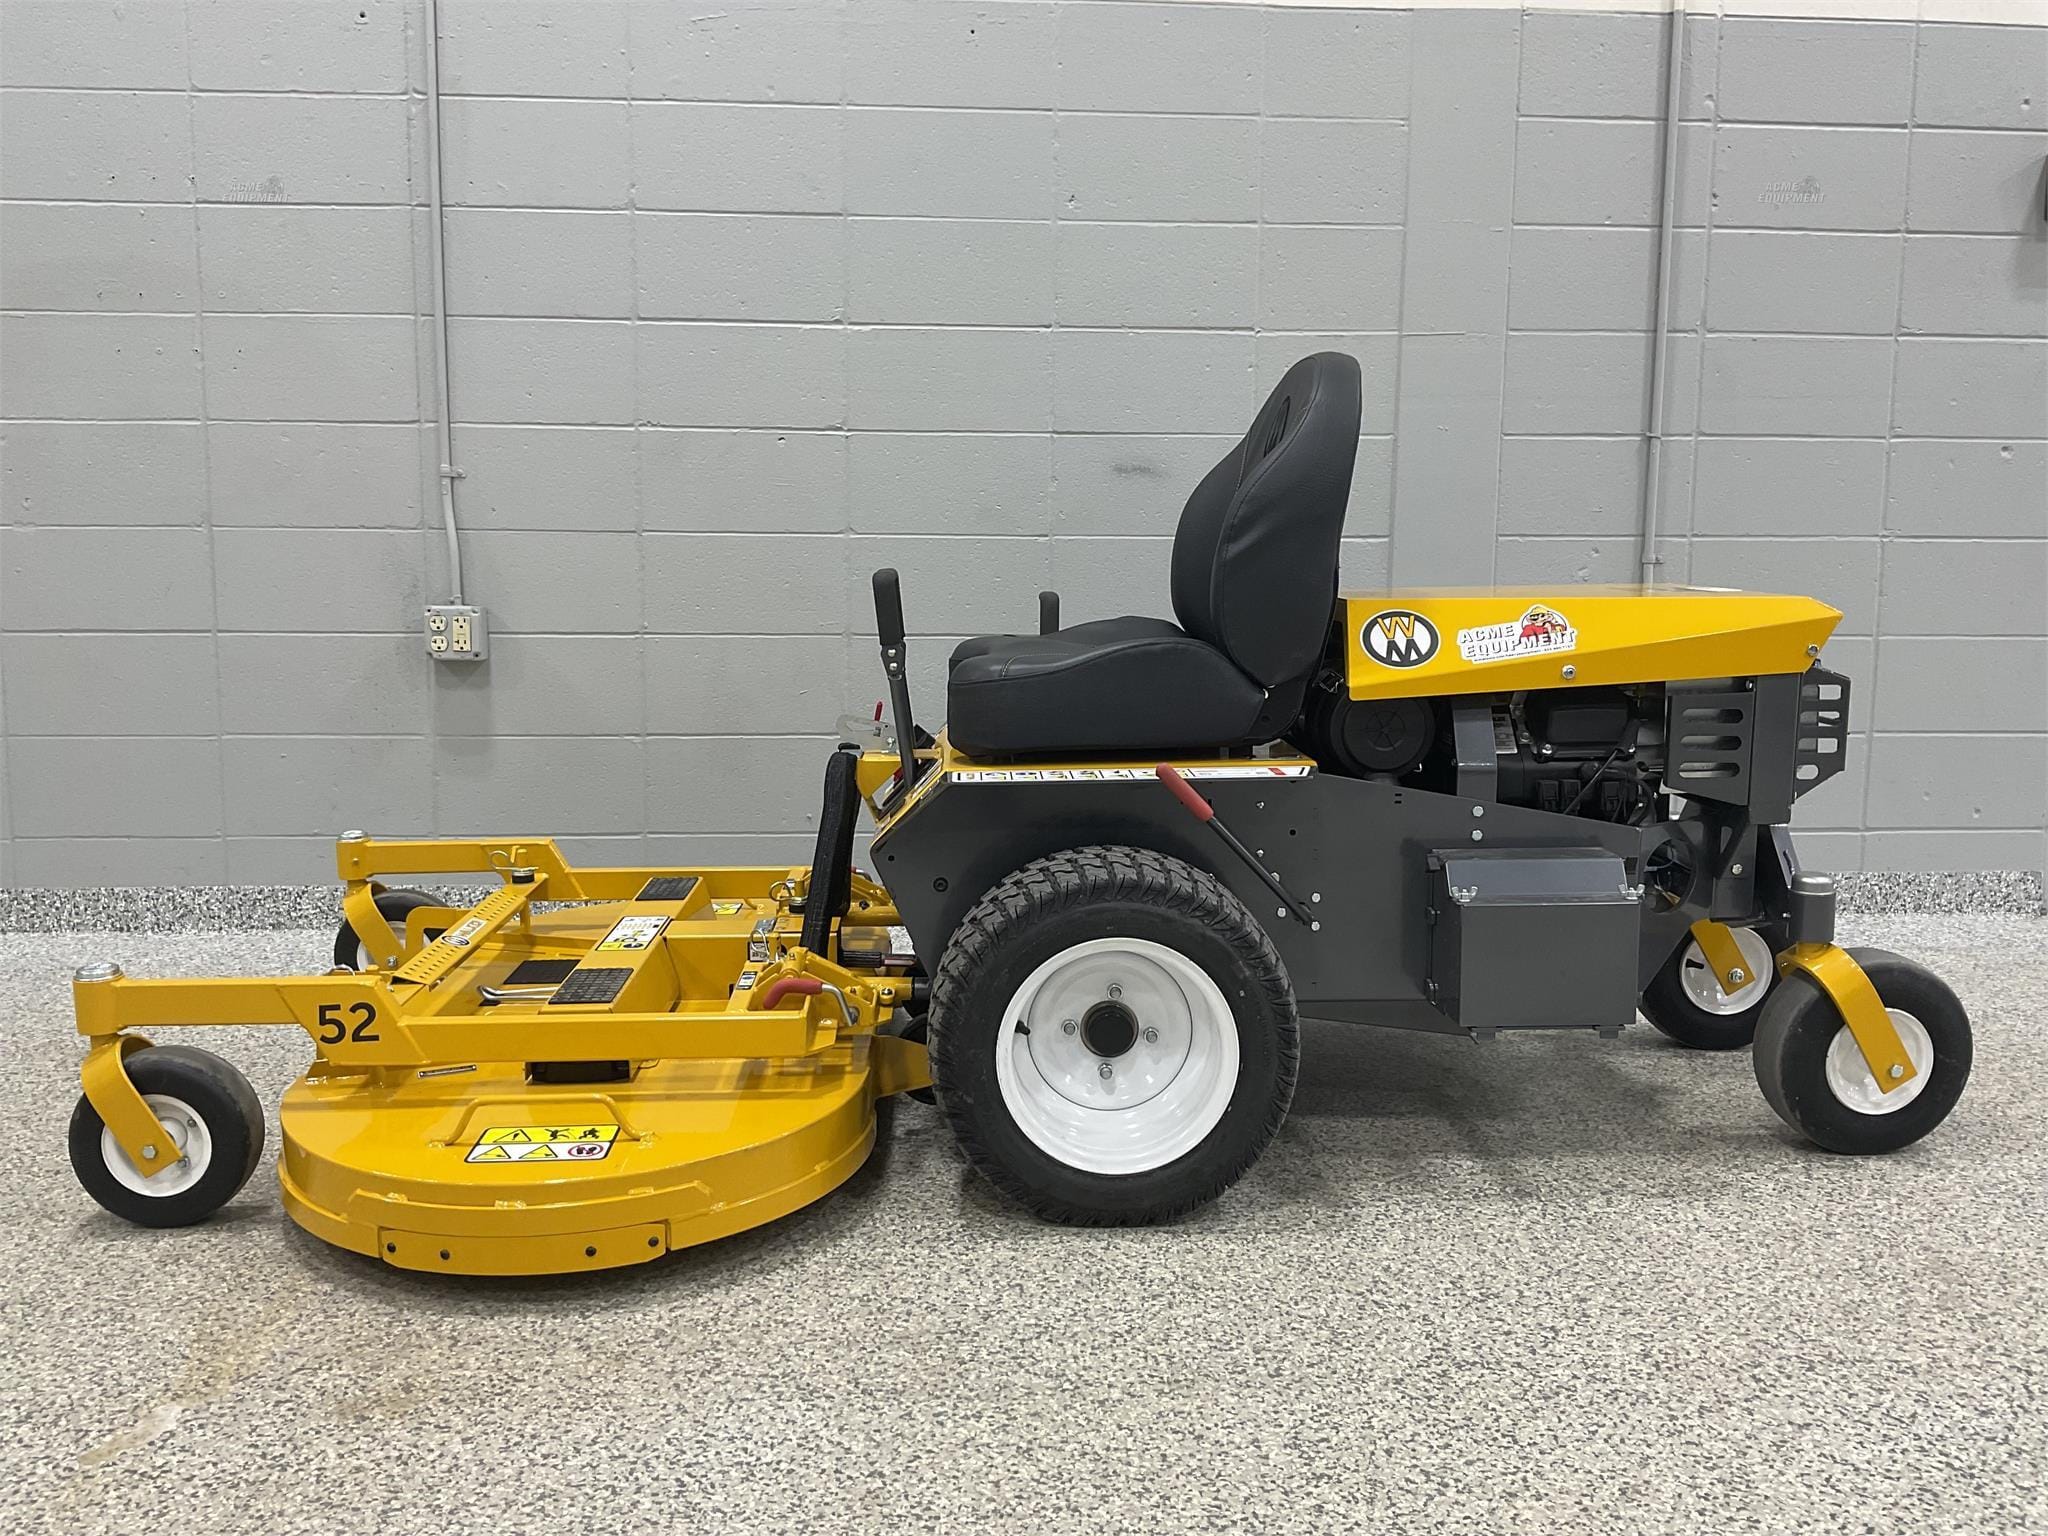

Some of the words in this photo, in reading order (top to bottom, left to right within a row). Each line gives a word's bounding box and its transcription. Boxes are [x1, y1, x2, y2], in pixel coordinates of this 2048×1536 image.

[1460, 625, 1516, 644] ACME
[1466, 630, 1576, 658] EQUIPMENT
[318, 1002, 380, 1045] 52
